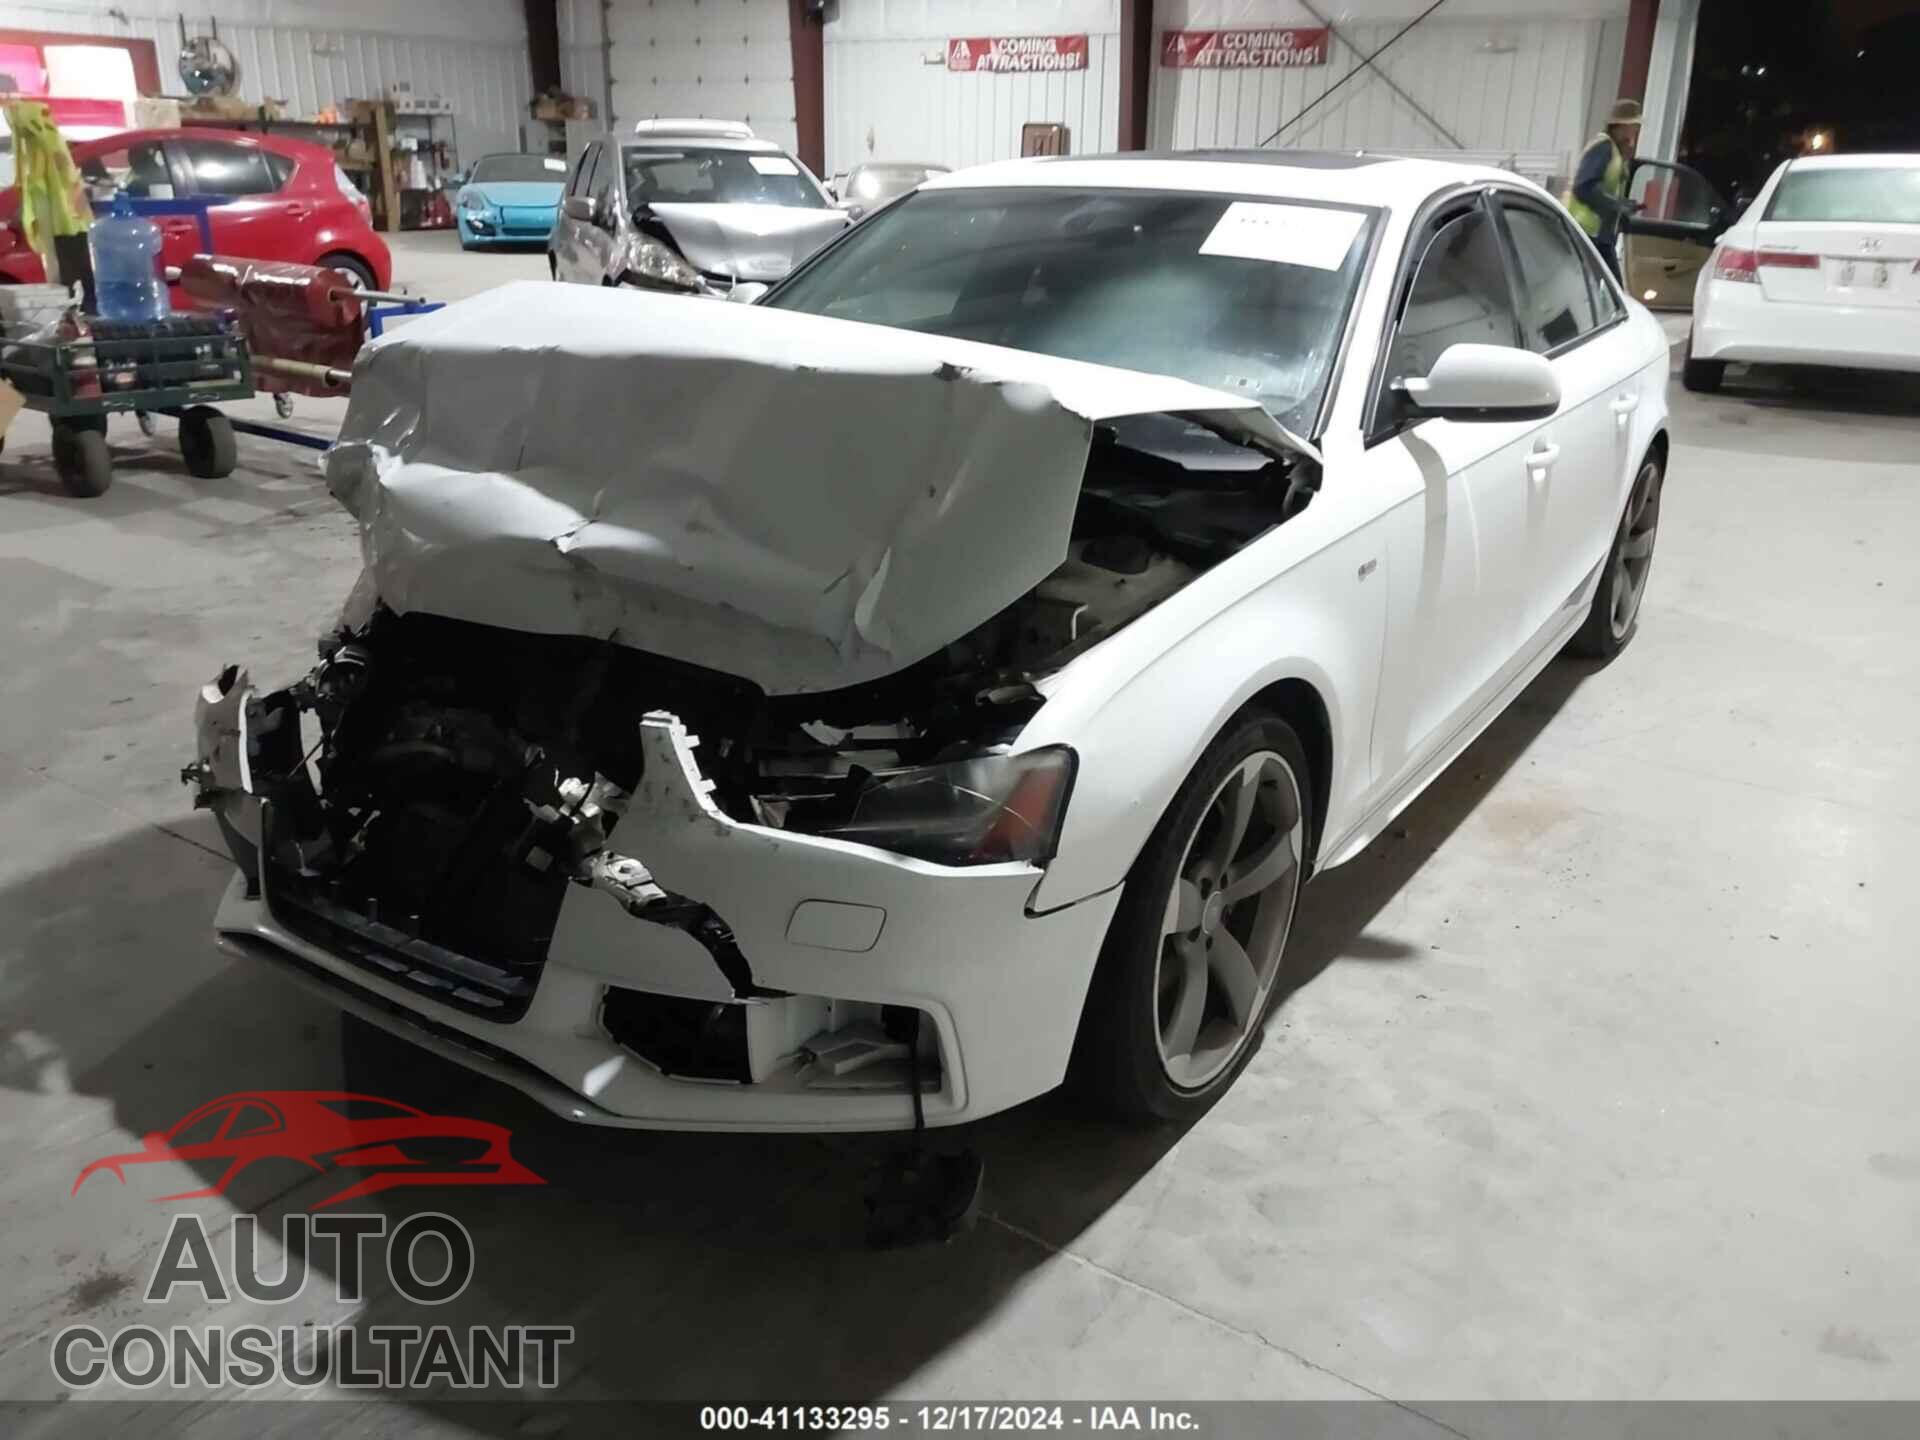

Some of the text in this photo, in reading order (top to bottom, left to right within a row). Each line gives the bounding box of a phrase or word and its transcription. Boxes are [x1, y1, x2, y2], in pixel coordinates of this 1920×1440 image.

[998, 37, 1057, 55] COMING
[1222, 31, 1295, 49] COMING
[976, 52, 1081, 71] ATTRACTIONS!
[1193, 46, 1320, 67] ATTRACTIONS!
